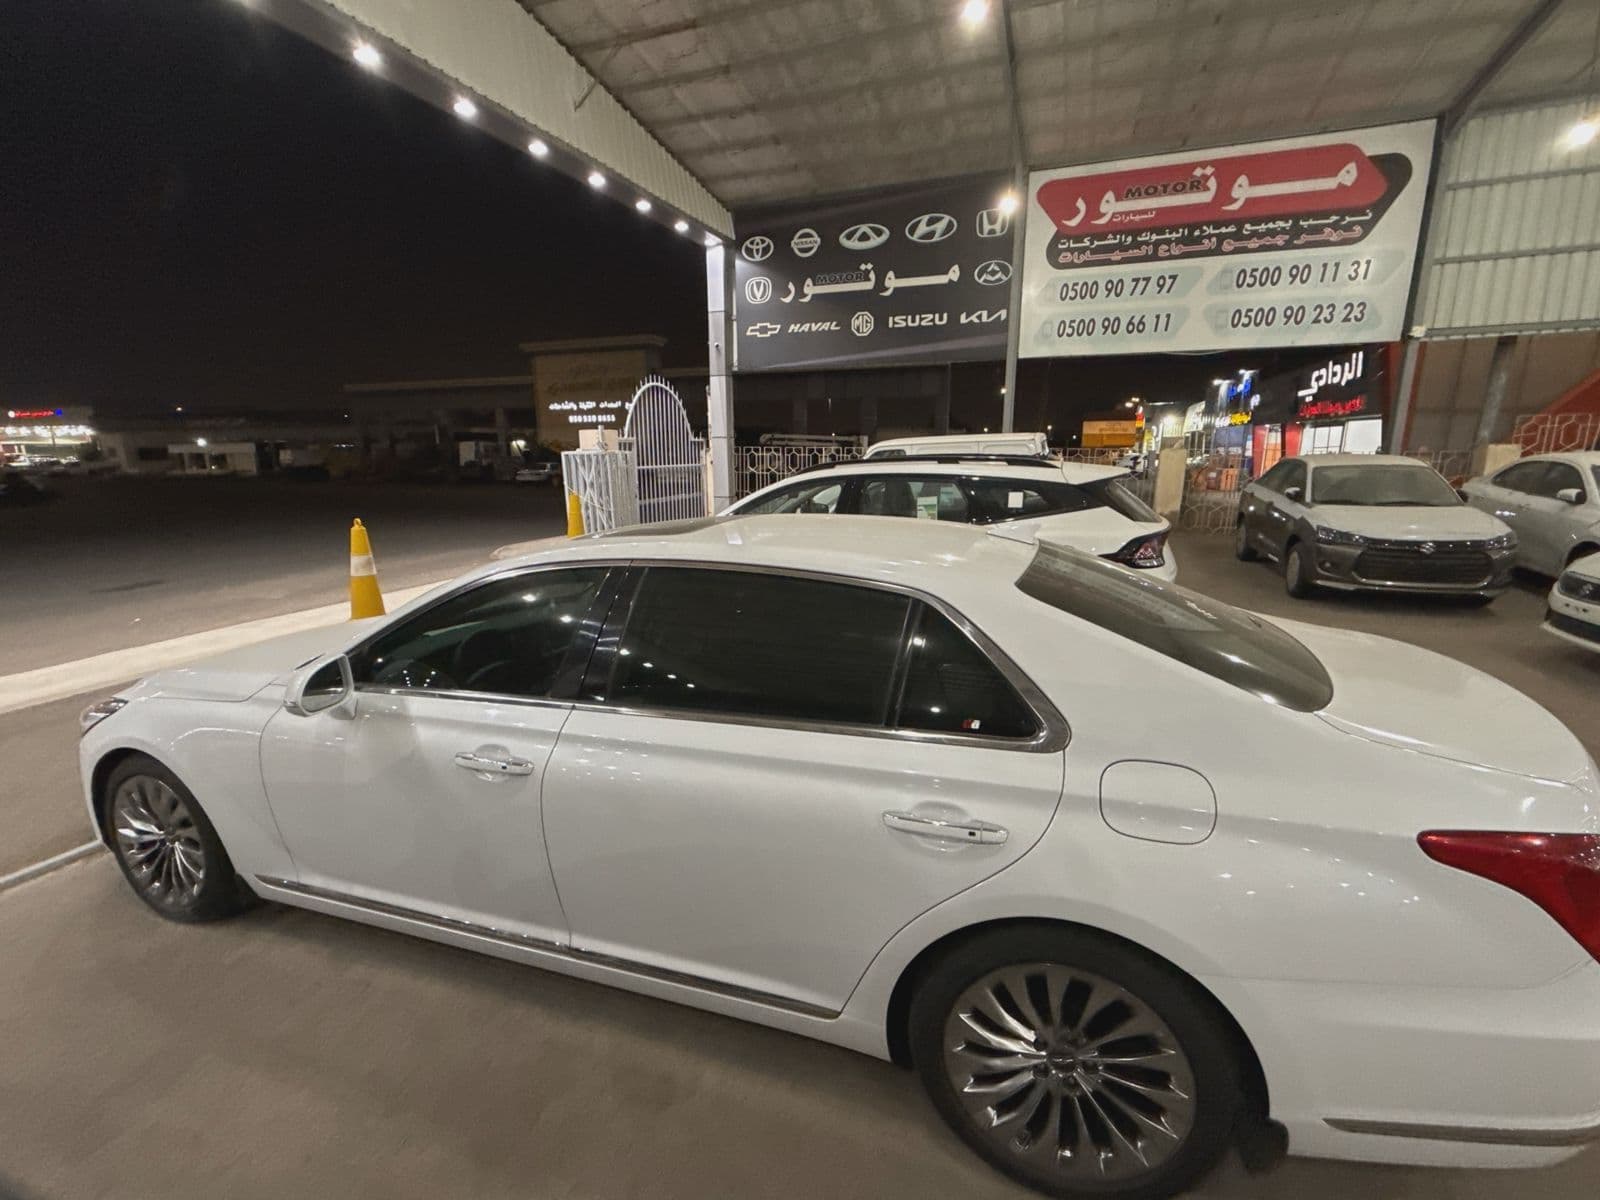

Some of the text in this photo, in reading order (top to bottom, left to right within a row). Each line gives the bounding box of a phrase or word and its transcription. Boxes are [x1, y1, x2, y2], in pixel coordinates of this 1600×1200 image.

[1062, 162, 1358, 227] موتور
[1124, 179, 1201, 199] MOTOR
[1112, 210, 1156, 222] للسيارات
[1057, 209, 1373, 249] نرحب بجميع عملاء البنوك والشركات
[1221, 234, 1290, 252] جميع
[1057, 244, 1153, 264] السيارات
[780, 262, 960, 303] موتور
[816, 271, 865, 283] MOTOR
[1235, 259, 1372, 289] 0500 90 11 31
[1059, 274, 1179, 301] 0500 90 77 97
[853, 314, 872, 334] MG
[888, 312, 948, 328] ISUZU
[959, 309, 1008, 324] KIA
[1230, 301, 1367, 328] 0500 90 23 23
[788, 321, 841, 333] HAVAL
[1056, 312, 1171, 338] 0500 90 66 11
[1297, 351, 1364, 402] الردادي
